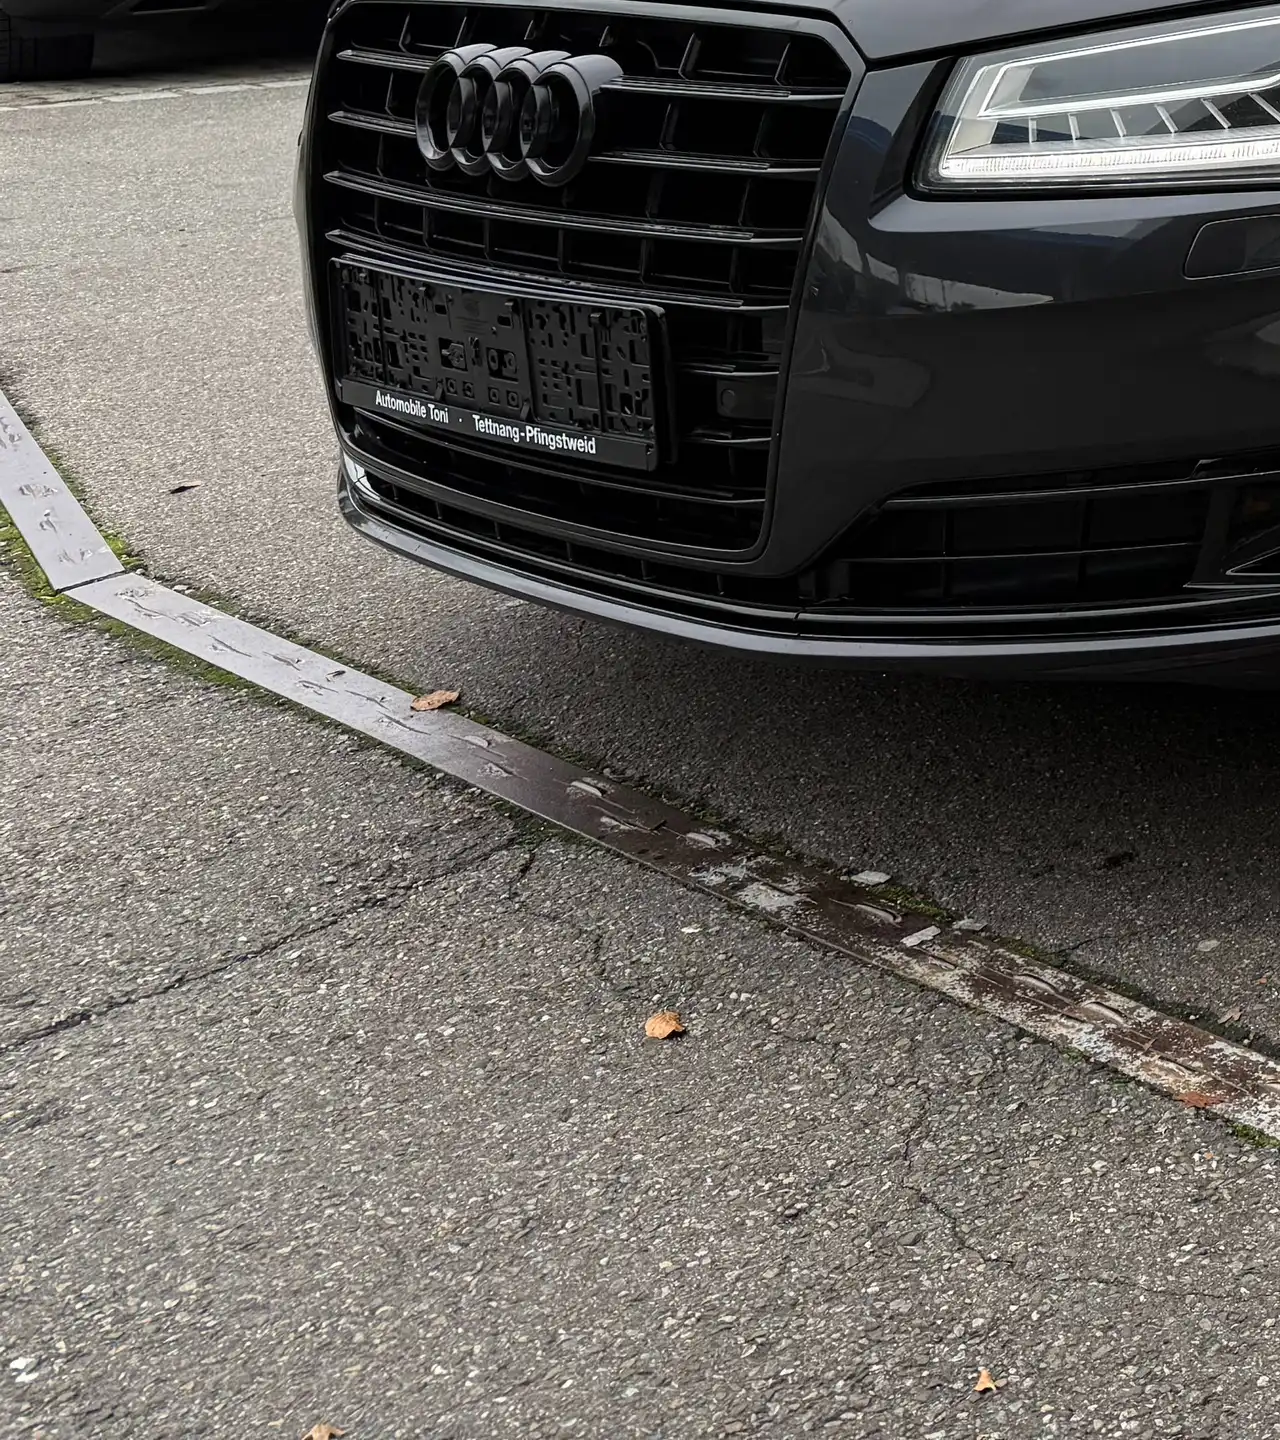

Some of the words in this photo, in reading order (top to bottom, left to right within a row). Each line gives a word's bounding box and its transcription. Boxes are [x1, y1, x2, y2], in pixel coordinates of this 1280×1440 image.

[375, 389, 427, 418] Automobile
[427, 403, 449, 424] Toni
[472, 414, 596, 454] Tettnang-Pfingstweid
